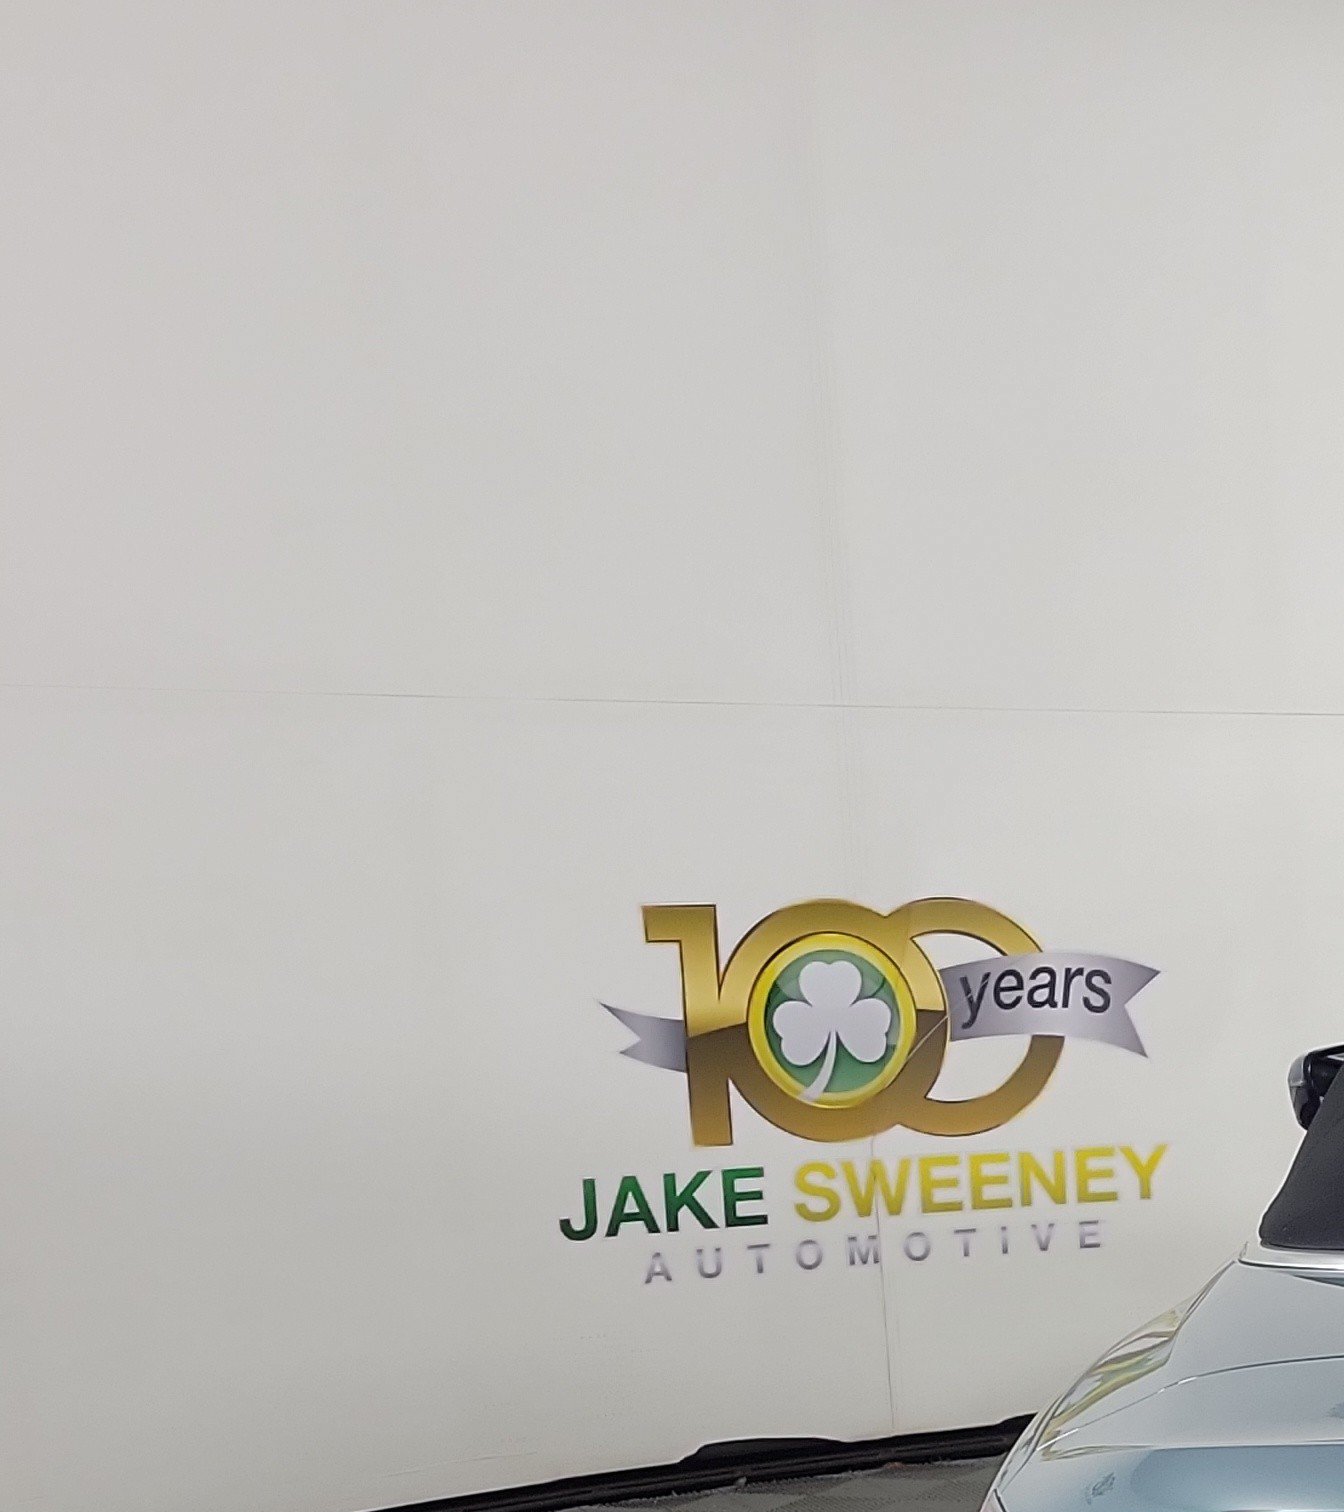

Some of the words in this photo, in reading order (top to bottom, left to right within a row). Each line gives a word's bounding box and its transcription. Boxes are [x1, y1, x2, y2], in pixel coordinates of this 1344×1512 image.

[640, 897, 1065, 1147] 100
[959, 965, 1113, 1029] years
[558, 1166, 769, 1242] JAKE
[793, 1144, 1169, 1223] SWEENEY
[643, 1219, 1104, 1285] AUTOMOTIVE
